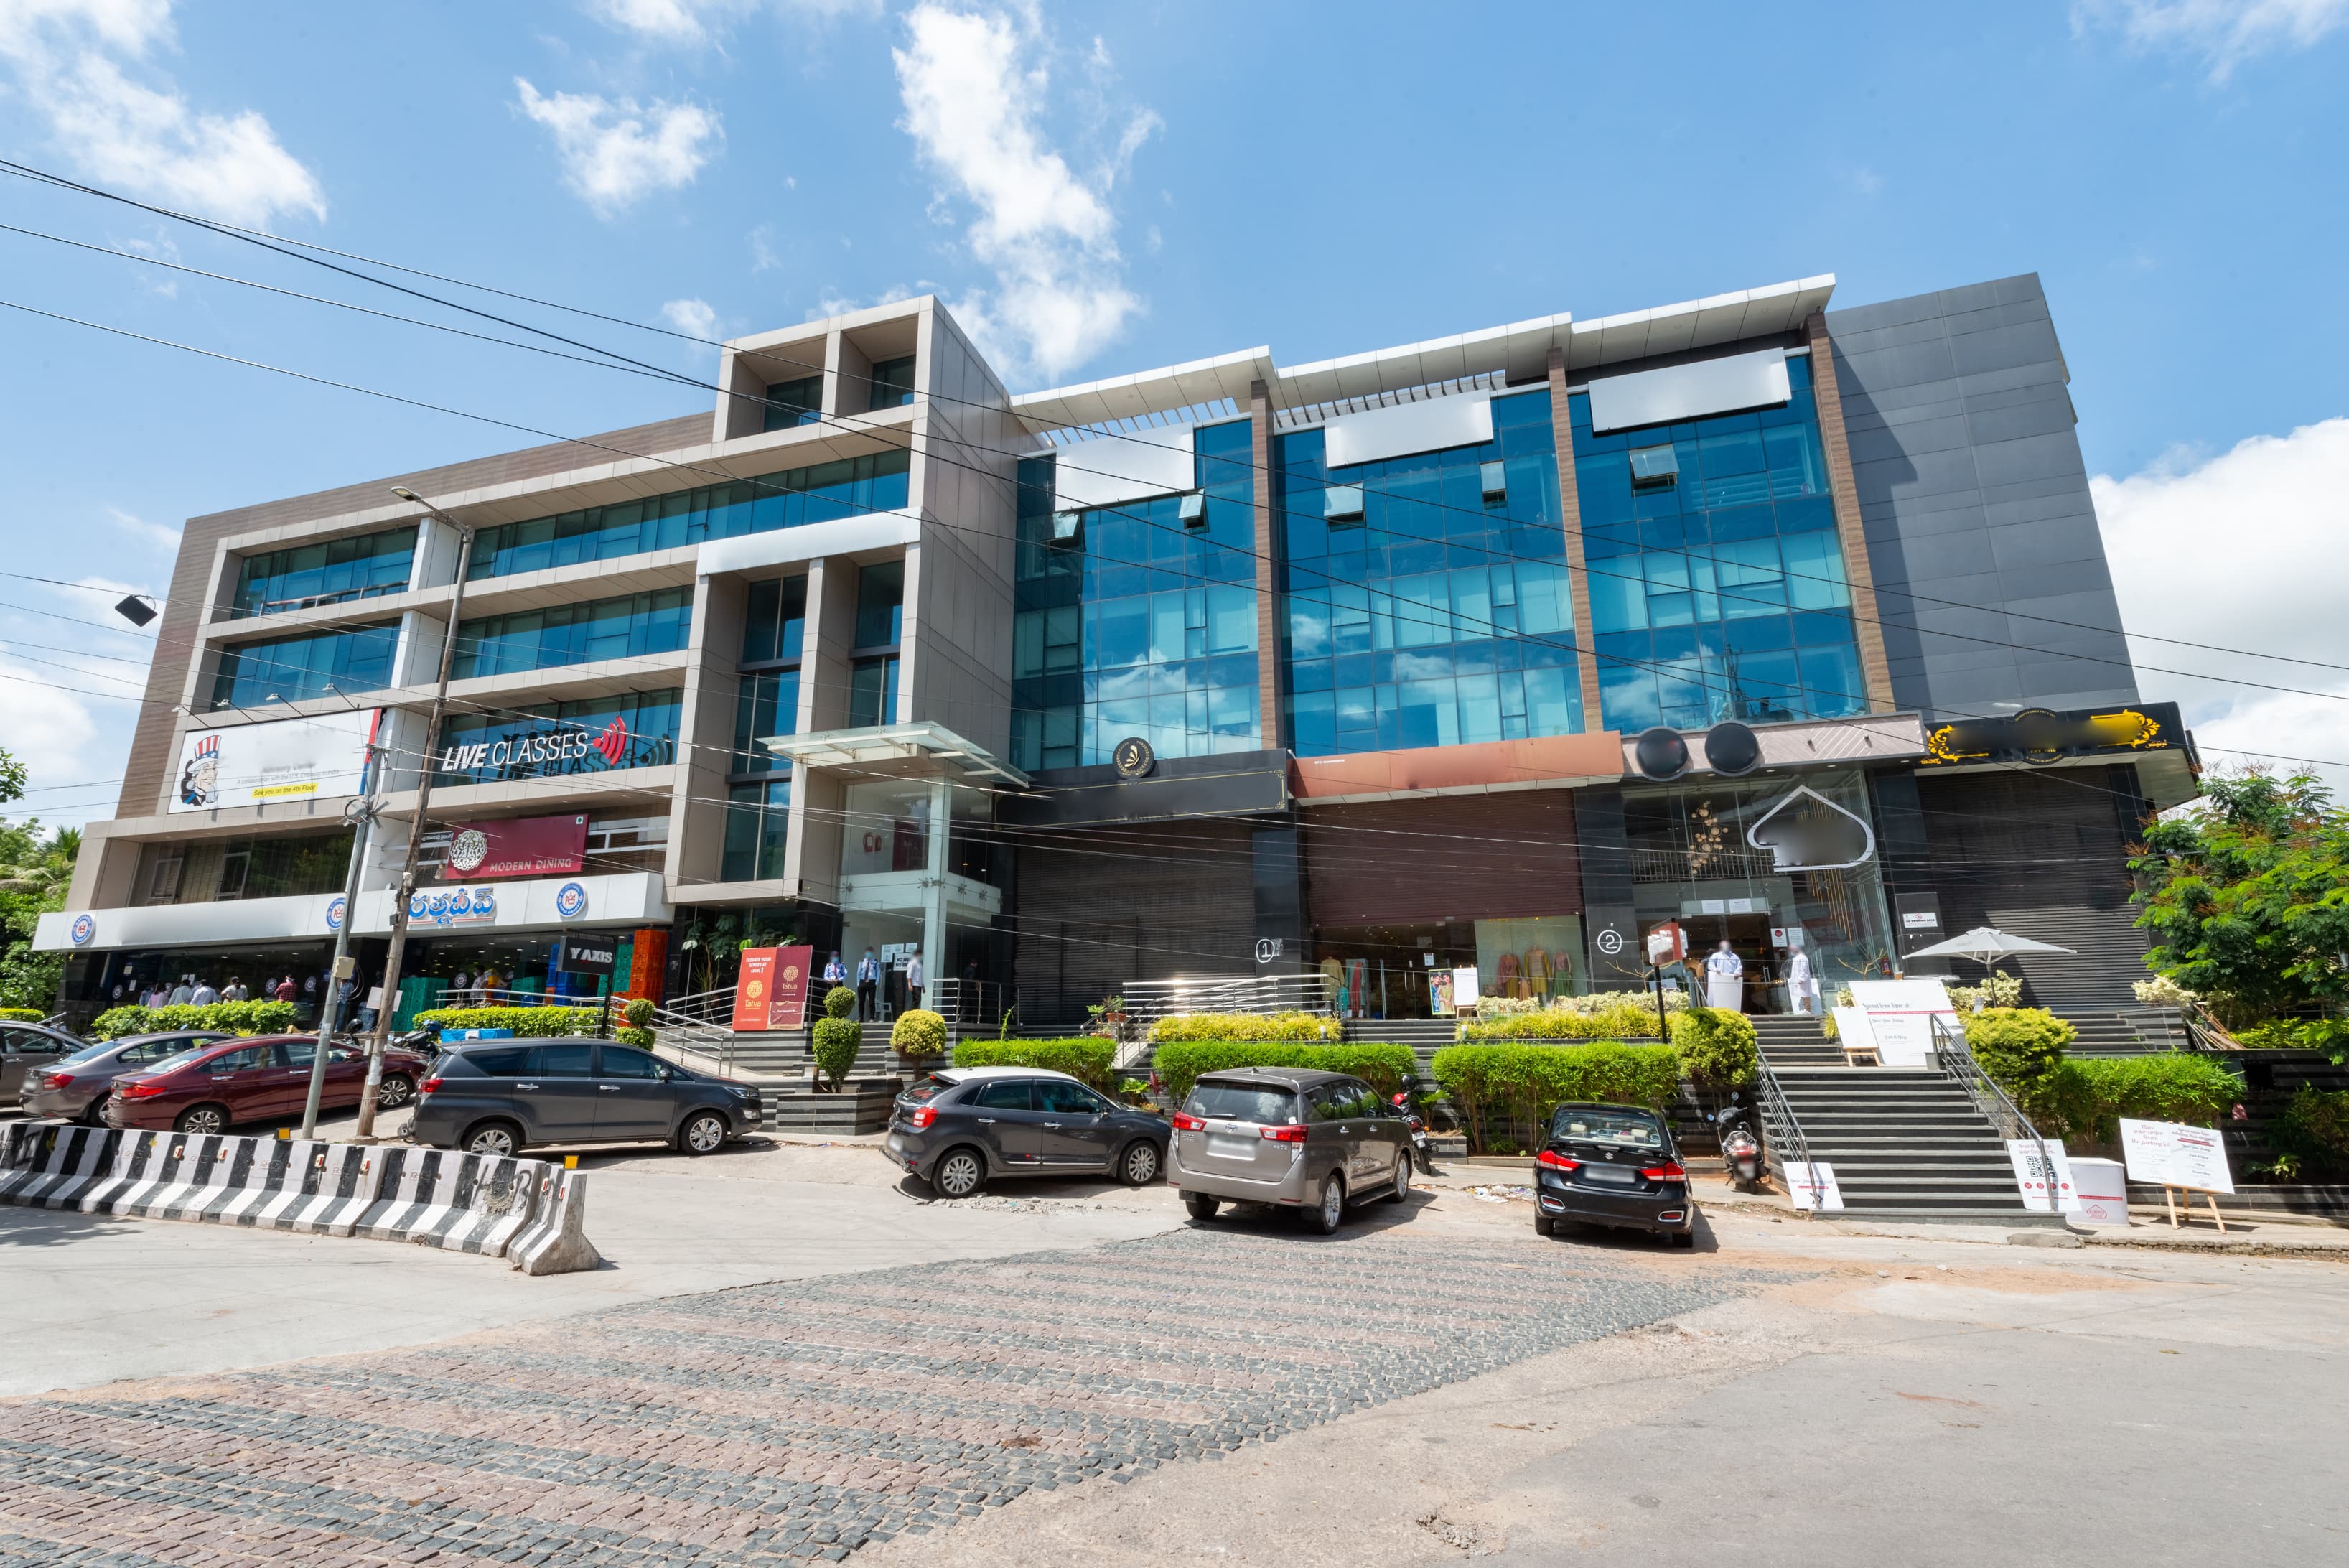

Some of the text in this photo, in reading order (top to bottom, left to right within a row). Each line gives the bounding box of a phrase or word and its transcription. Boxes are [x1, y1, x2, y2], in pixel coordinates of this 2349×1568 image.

[441, 732, 589, 772] LIVE CLASSES
[490, 858, 572, 873] MODERN DINING
